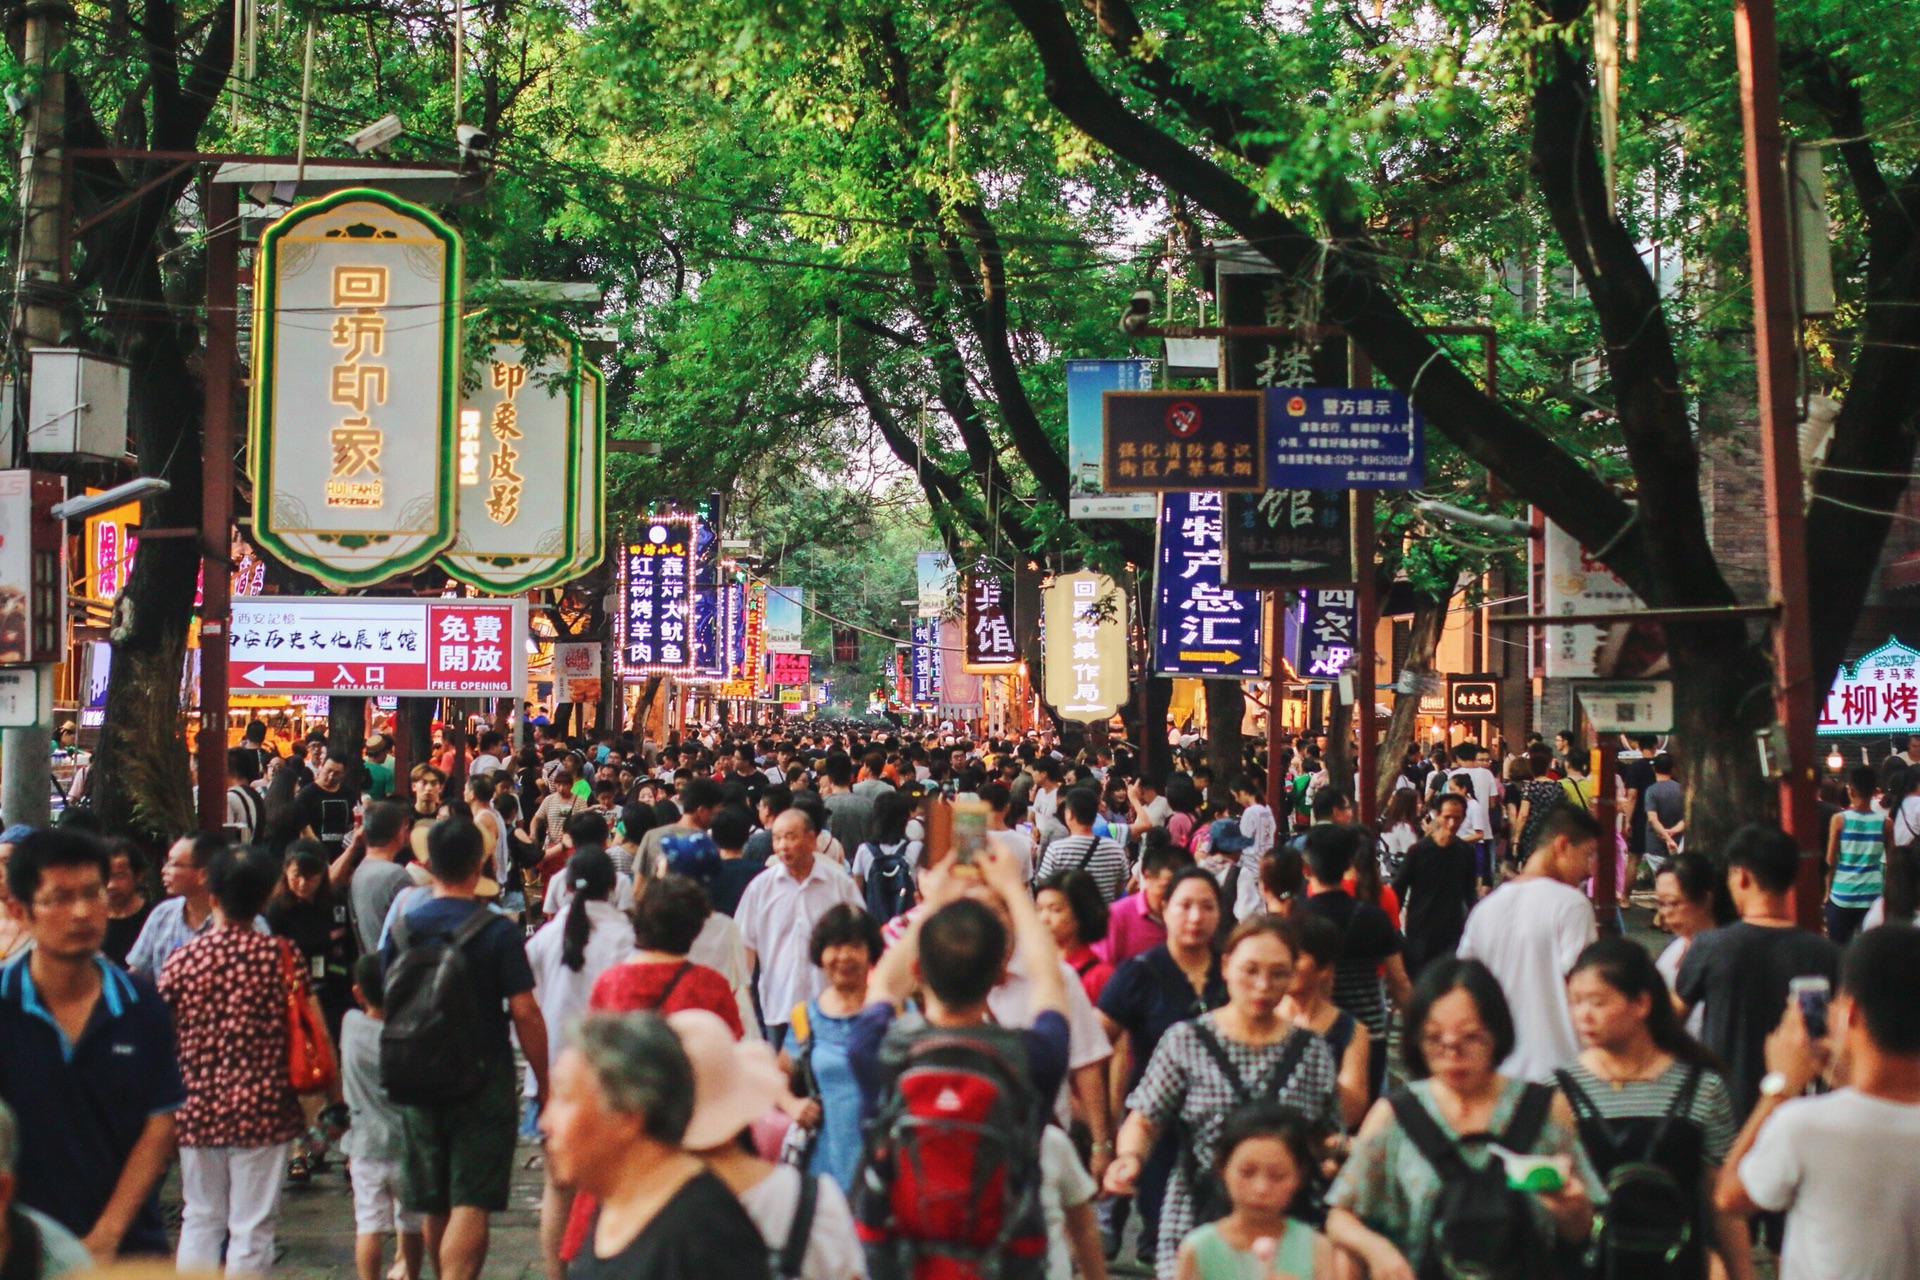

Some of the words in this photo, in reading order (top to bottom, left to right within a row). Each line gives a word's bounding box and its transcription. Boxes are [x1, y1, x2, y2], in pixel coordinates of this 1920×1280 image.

[1323, 398, 1391, 416] 警方提示
[485, 362, 526, 527] 印象皮影
[1118, 441, 1252, 459] 强化消防意识
[1118, 459, 1252, 478] 街区严禁吸烟
[237, 612, 296, 625] 西安記憶
[630, 556, 654, 663] 红柳烤羊肉
[660, 556, 684, 663] 轰炸大鱿鱼
[439, 614, 502, 643] 免費
[439, 645, 502, 673] 開放
[332, 665, 386, 684] 入口
[1873, 668, 1916, 681] 老马家
[431, 681, 457, 690] FREE
[460, 681, 508, 691] OPENING
